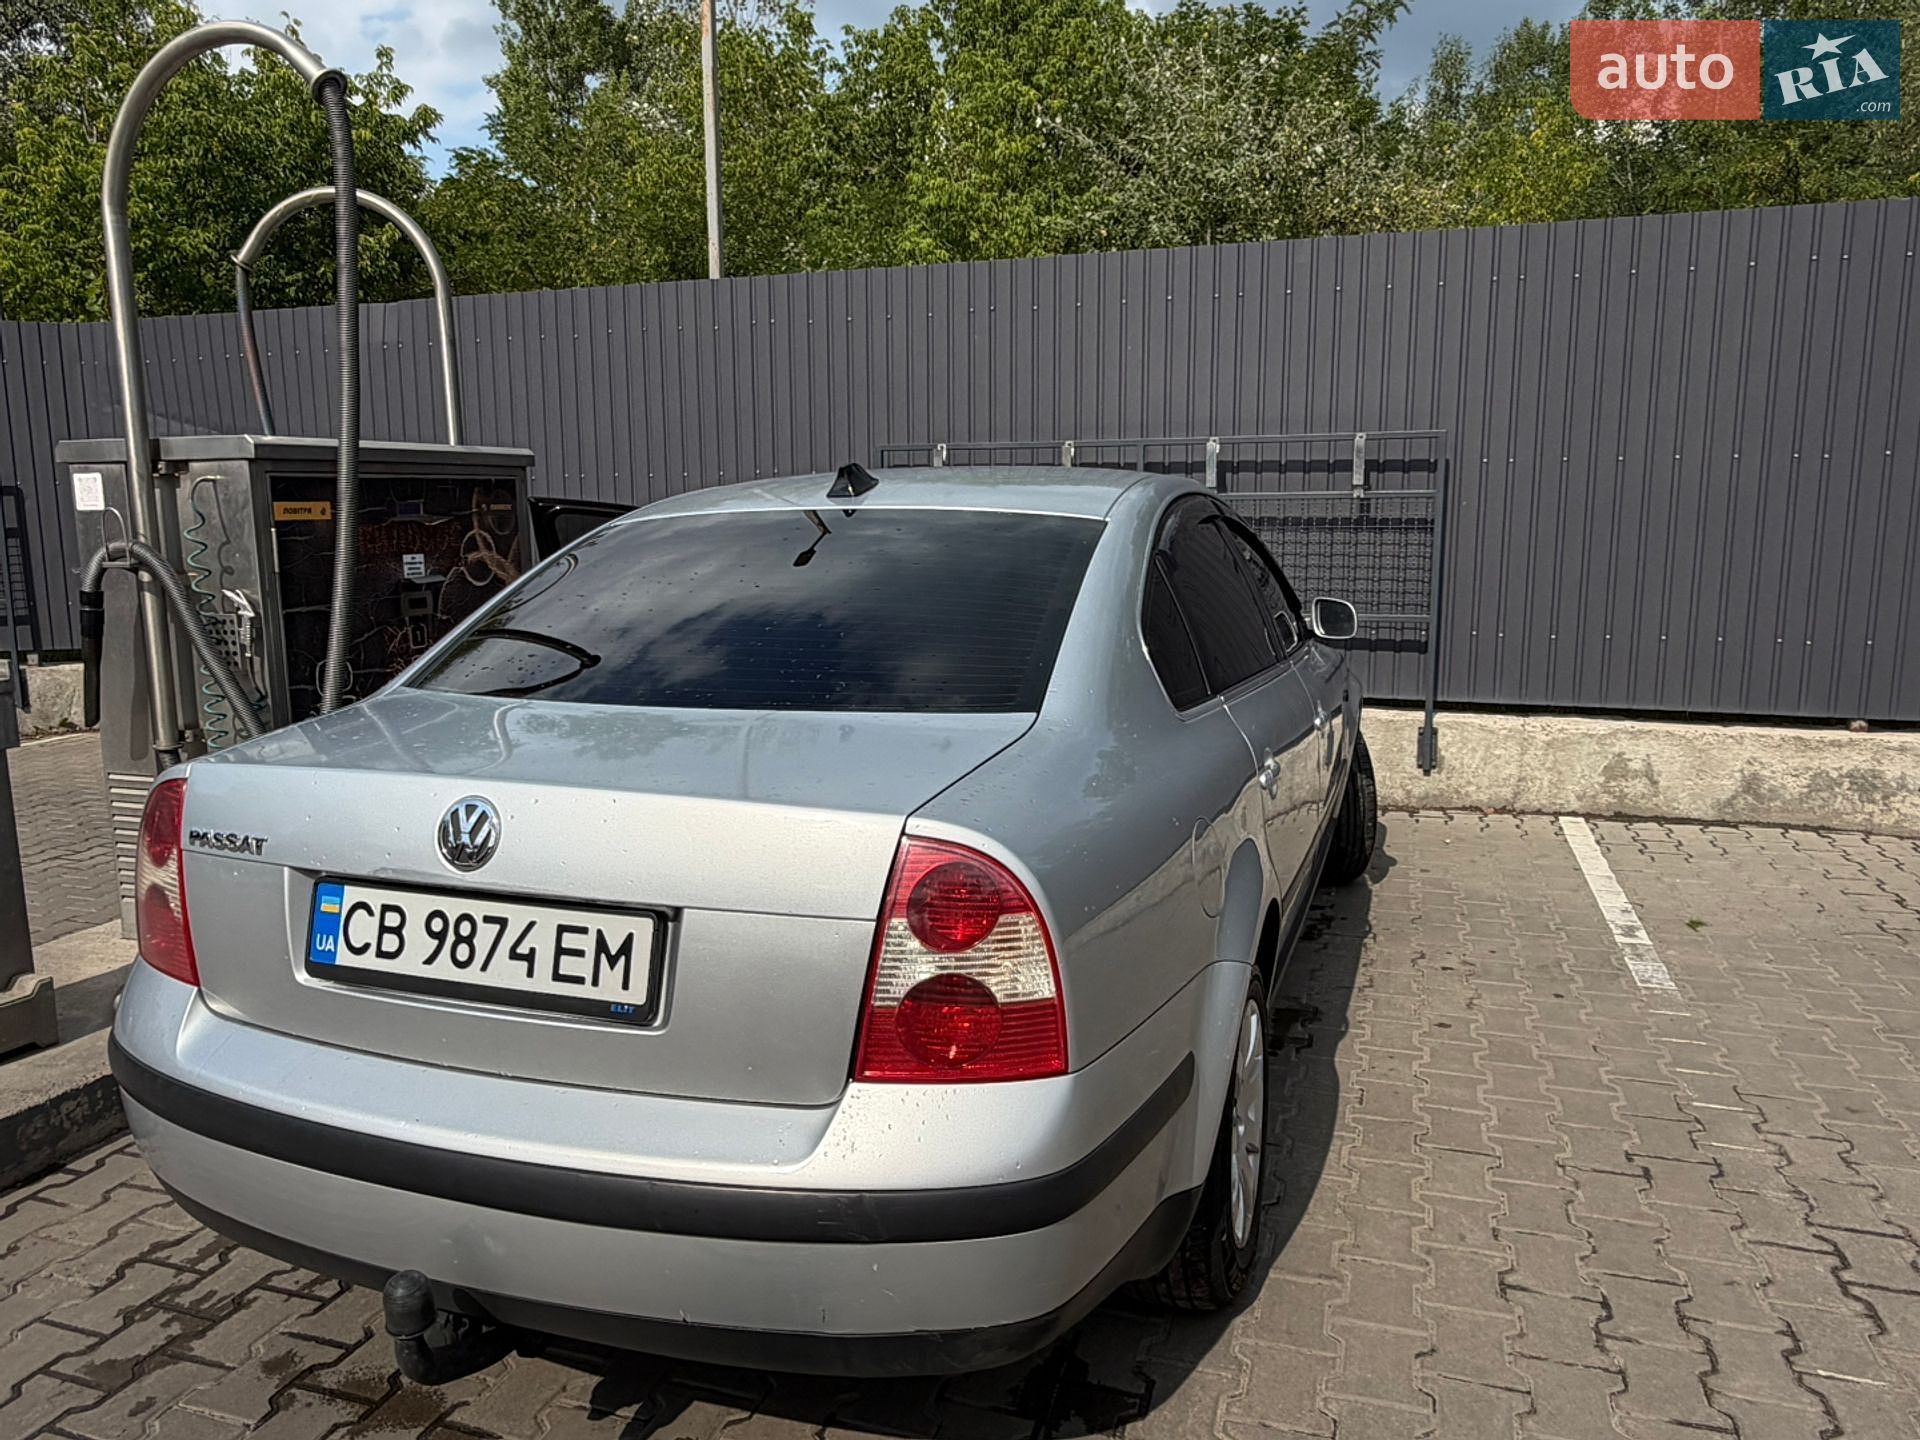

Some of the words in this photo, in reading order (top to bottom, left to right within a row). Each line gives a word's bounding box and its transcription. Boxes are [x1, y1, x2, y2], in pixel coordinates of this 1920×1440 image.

[189, 829, 268, 856] PASSAT
[315, 933, 335, 952] UA
[343, 901, 407, 959] CB
[422, 909, 538, 979] 9874
[551, 924, 634, 991] EM
